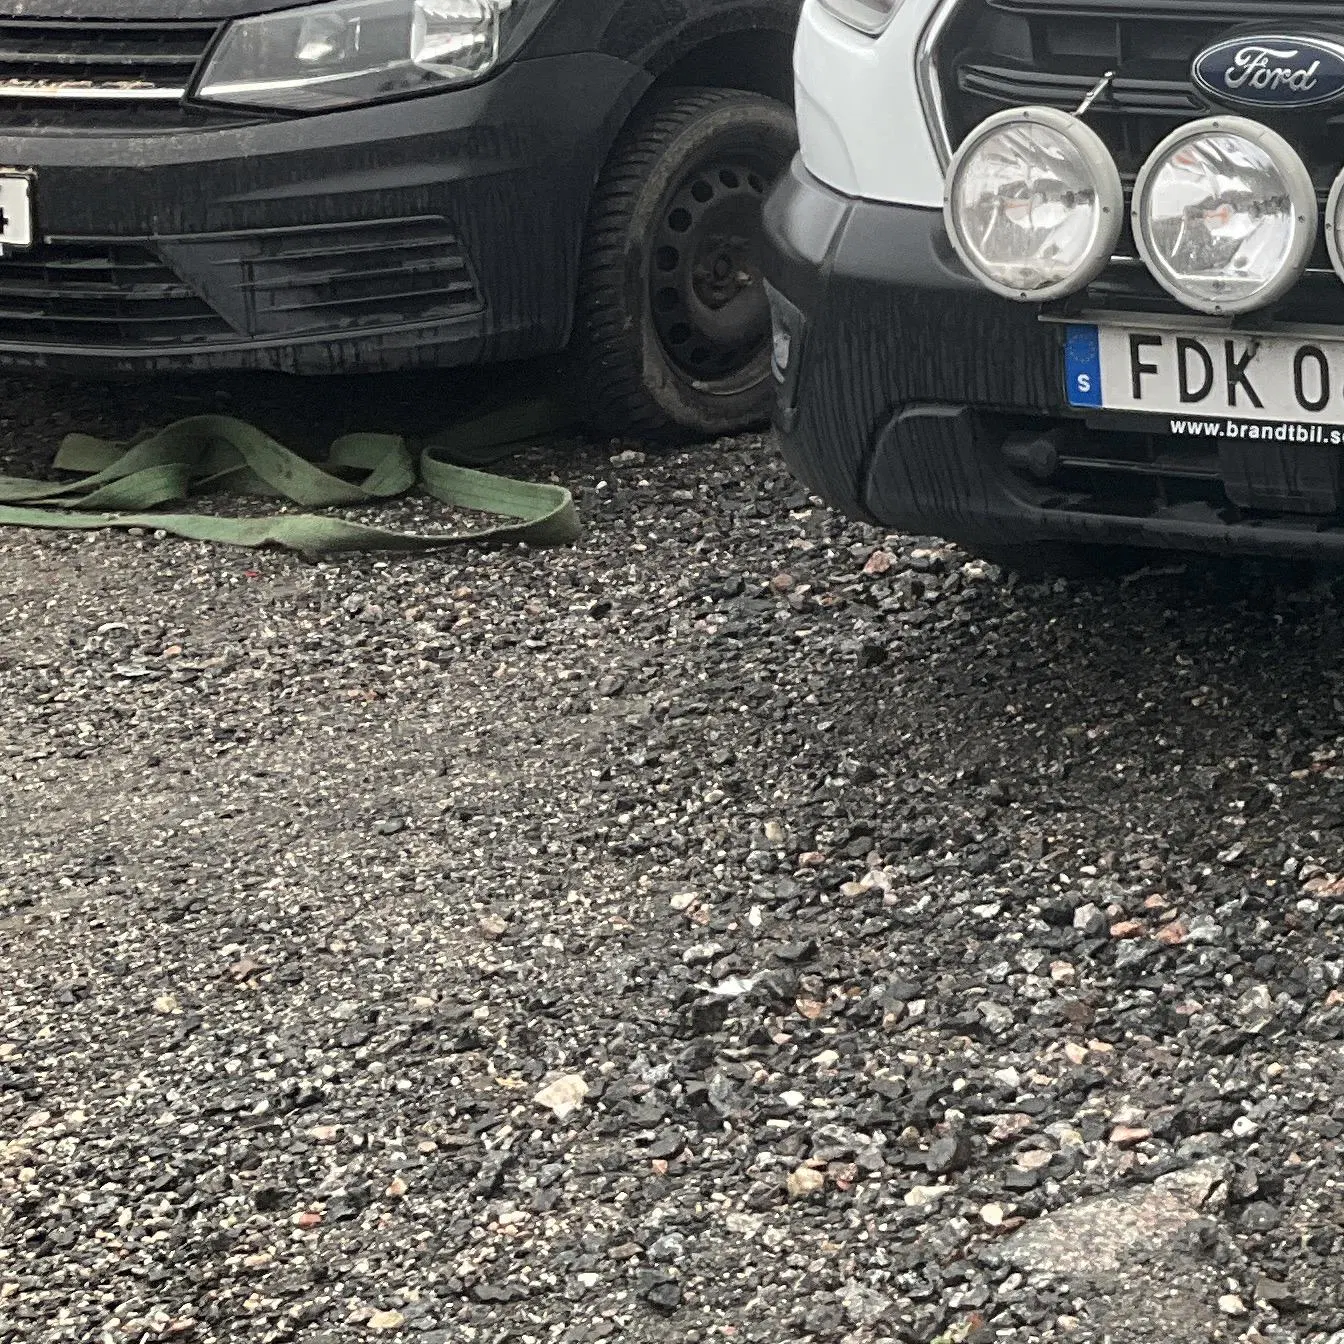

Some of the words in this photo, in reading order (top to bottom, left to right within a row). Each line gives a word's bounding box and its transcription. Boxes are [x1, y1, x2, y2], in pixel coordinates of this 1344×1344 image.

[1224, 45, 1321, 92] Ford
[1077, 373, 1091, 393] S
[1129, 332, 1265, 409] FDK
